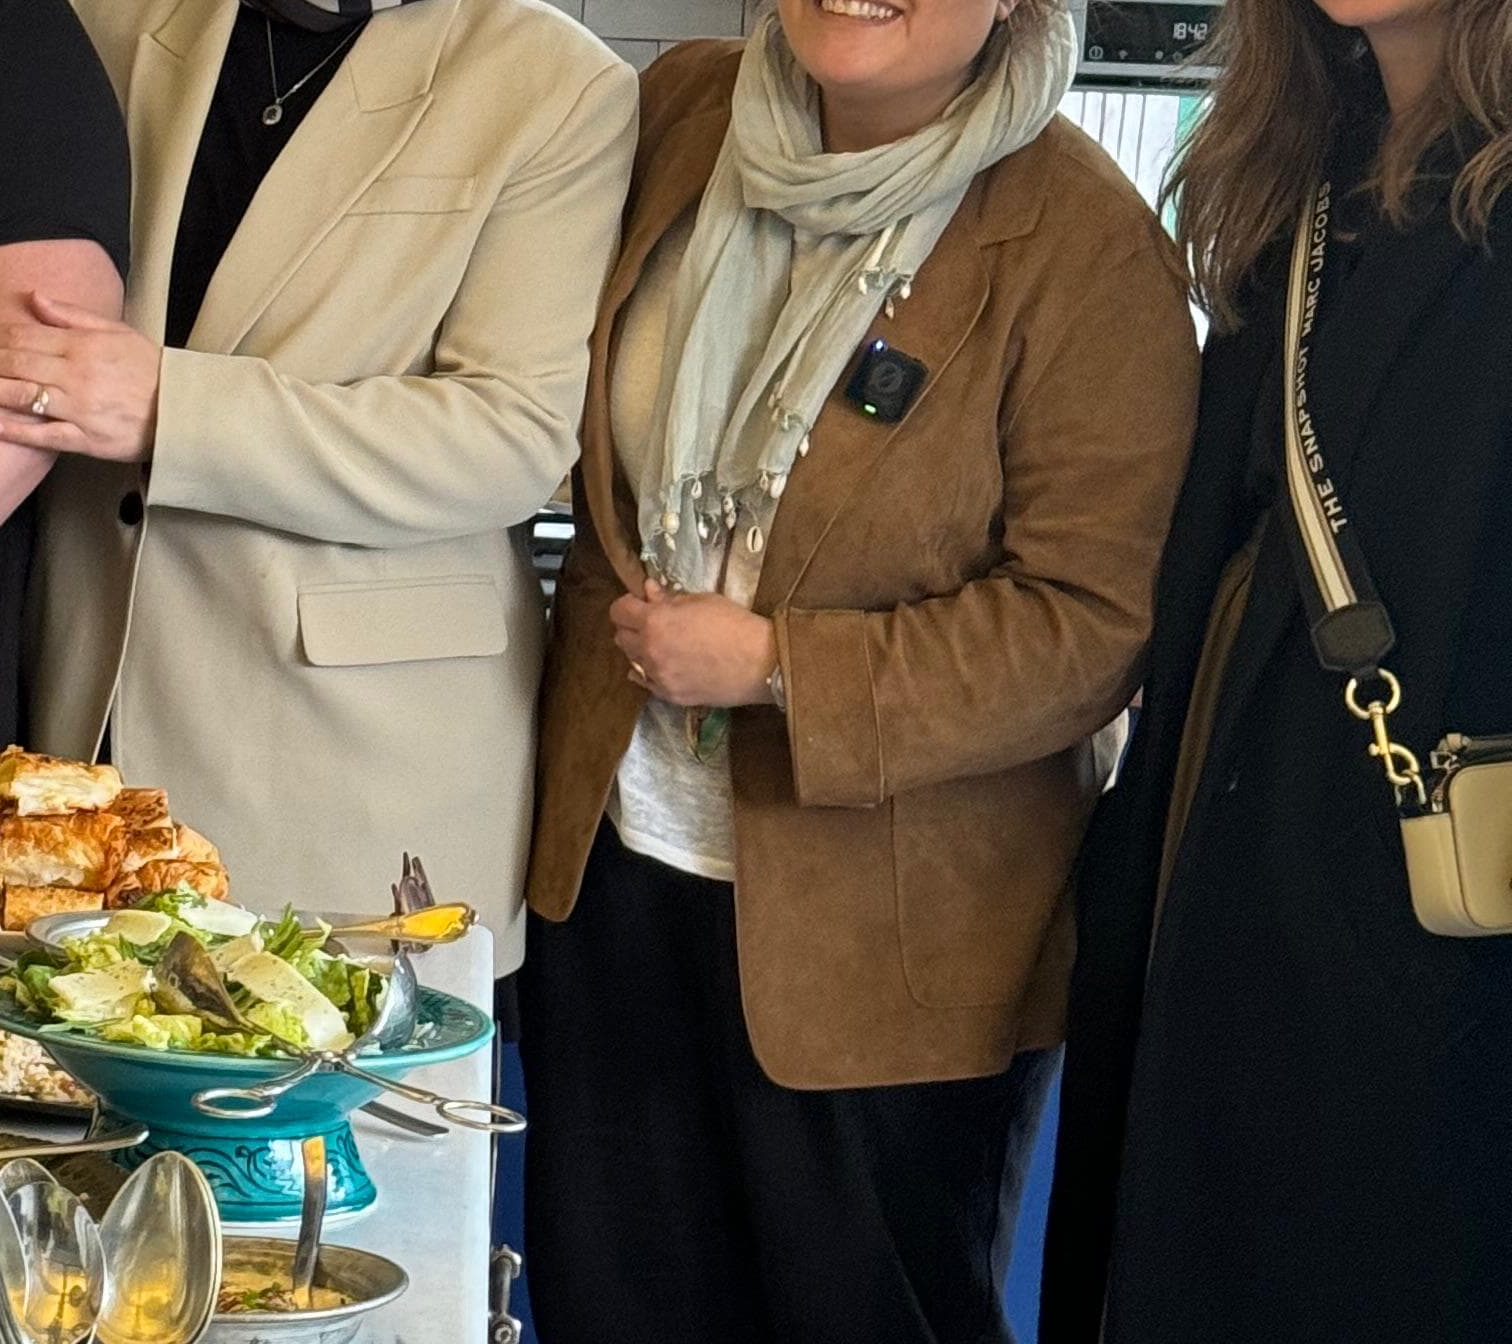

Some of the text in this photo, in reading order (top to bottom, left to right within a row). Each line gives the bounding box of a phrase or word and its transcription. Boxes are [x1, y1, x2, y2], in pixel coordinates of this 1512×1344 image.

[1296, 180, 1348, 534] THE SNAPSHOT MARC JACOBS
